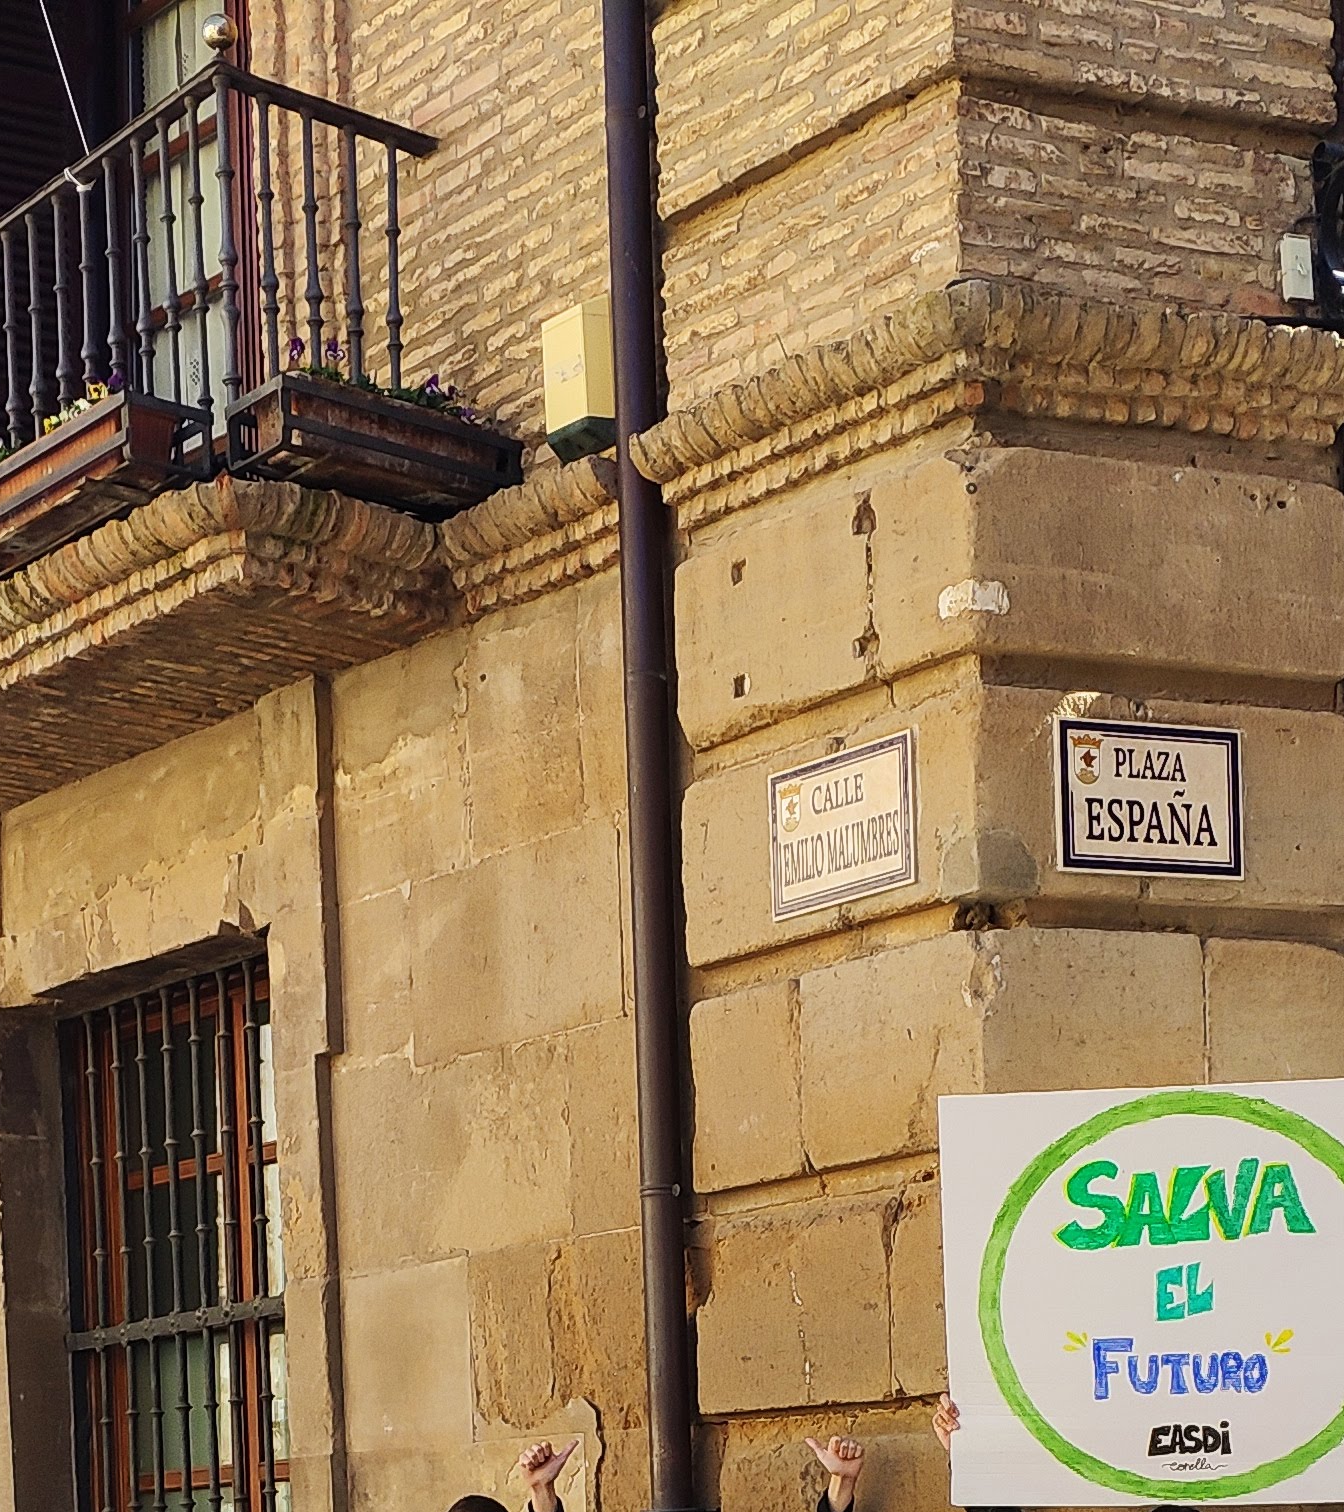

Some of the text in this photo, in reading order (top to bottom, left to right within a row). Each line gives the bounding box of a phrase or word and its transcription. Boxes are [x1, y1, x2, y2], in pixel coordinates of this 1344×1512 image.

[811, 773, 864, 815] CALLE
[1112, 746, 1187, 783] PLAZA
[1085, 788, 1218, 847] ESPAÑA
[783, 808, 900, 887] EMILIO MALUMBRES
[1054, 1158, 1316, 1250] SALVA
[1155, 1262, 1214, 1321] EL
